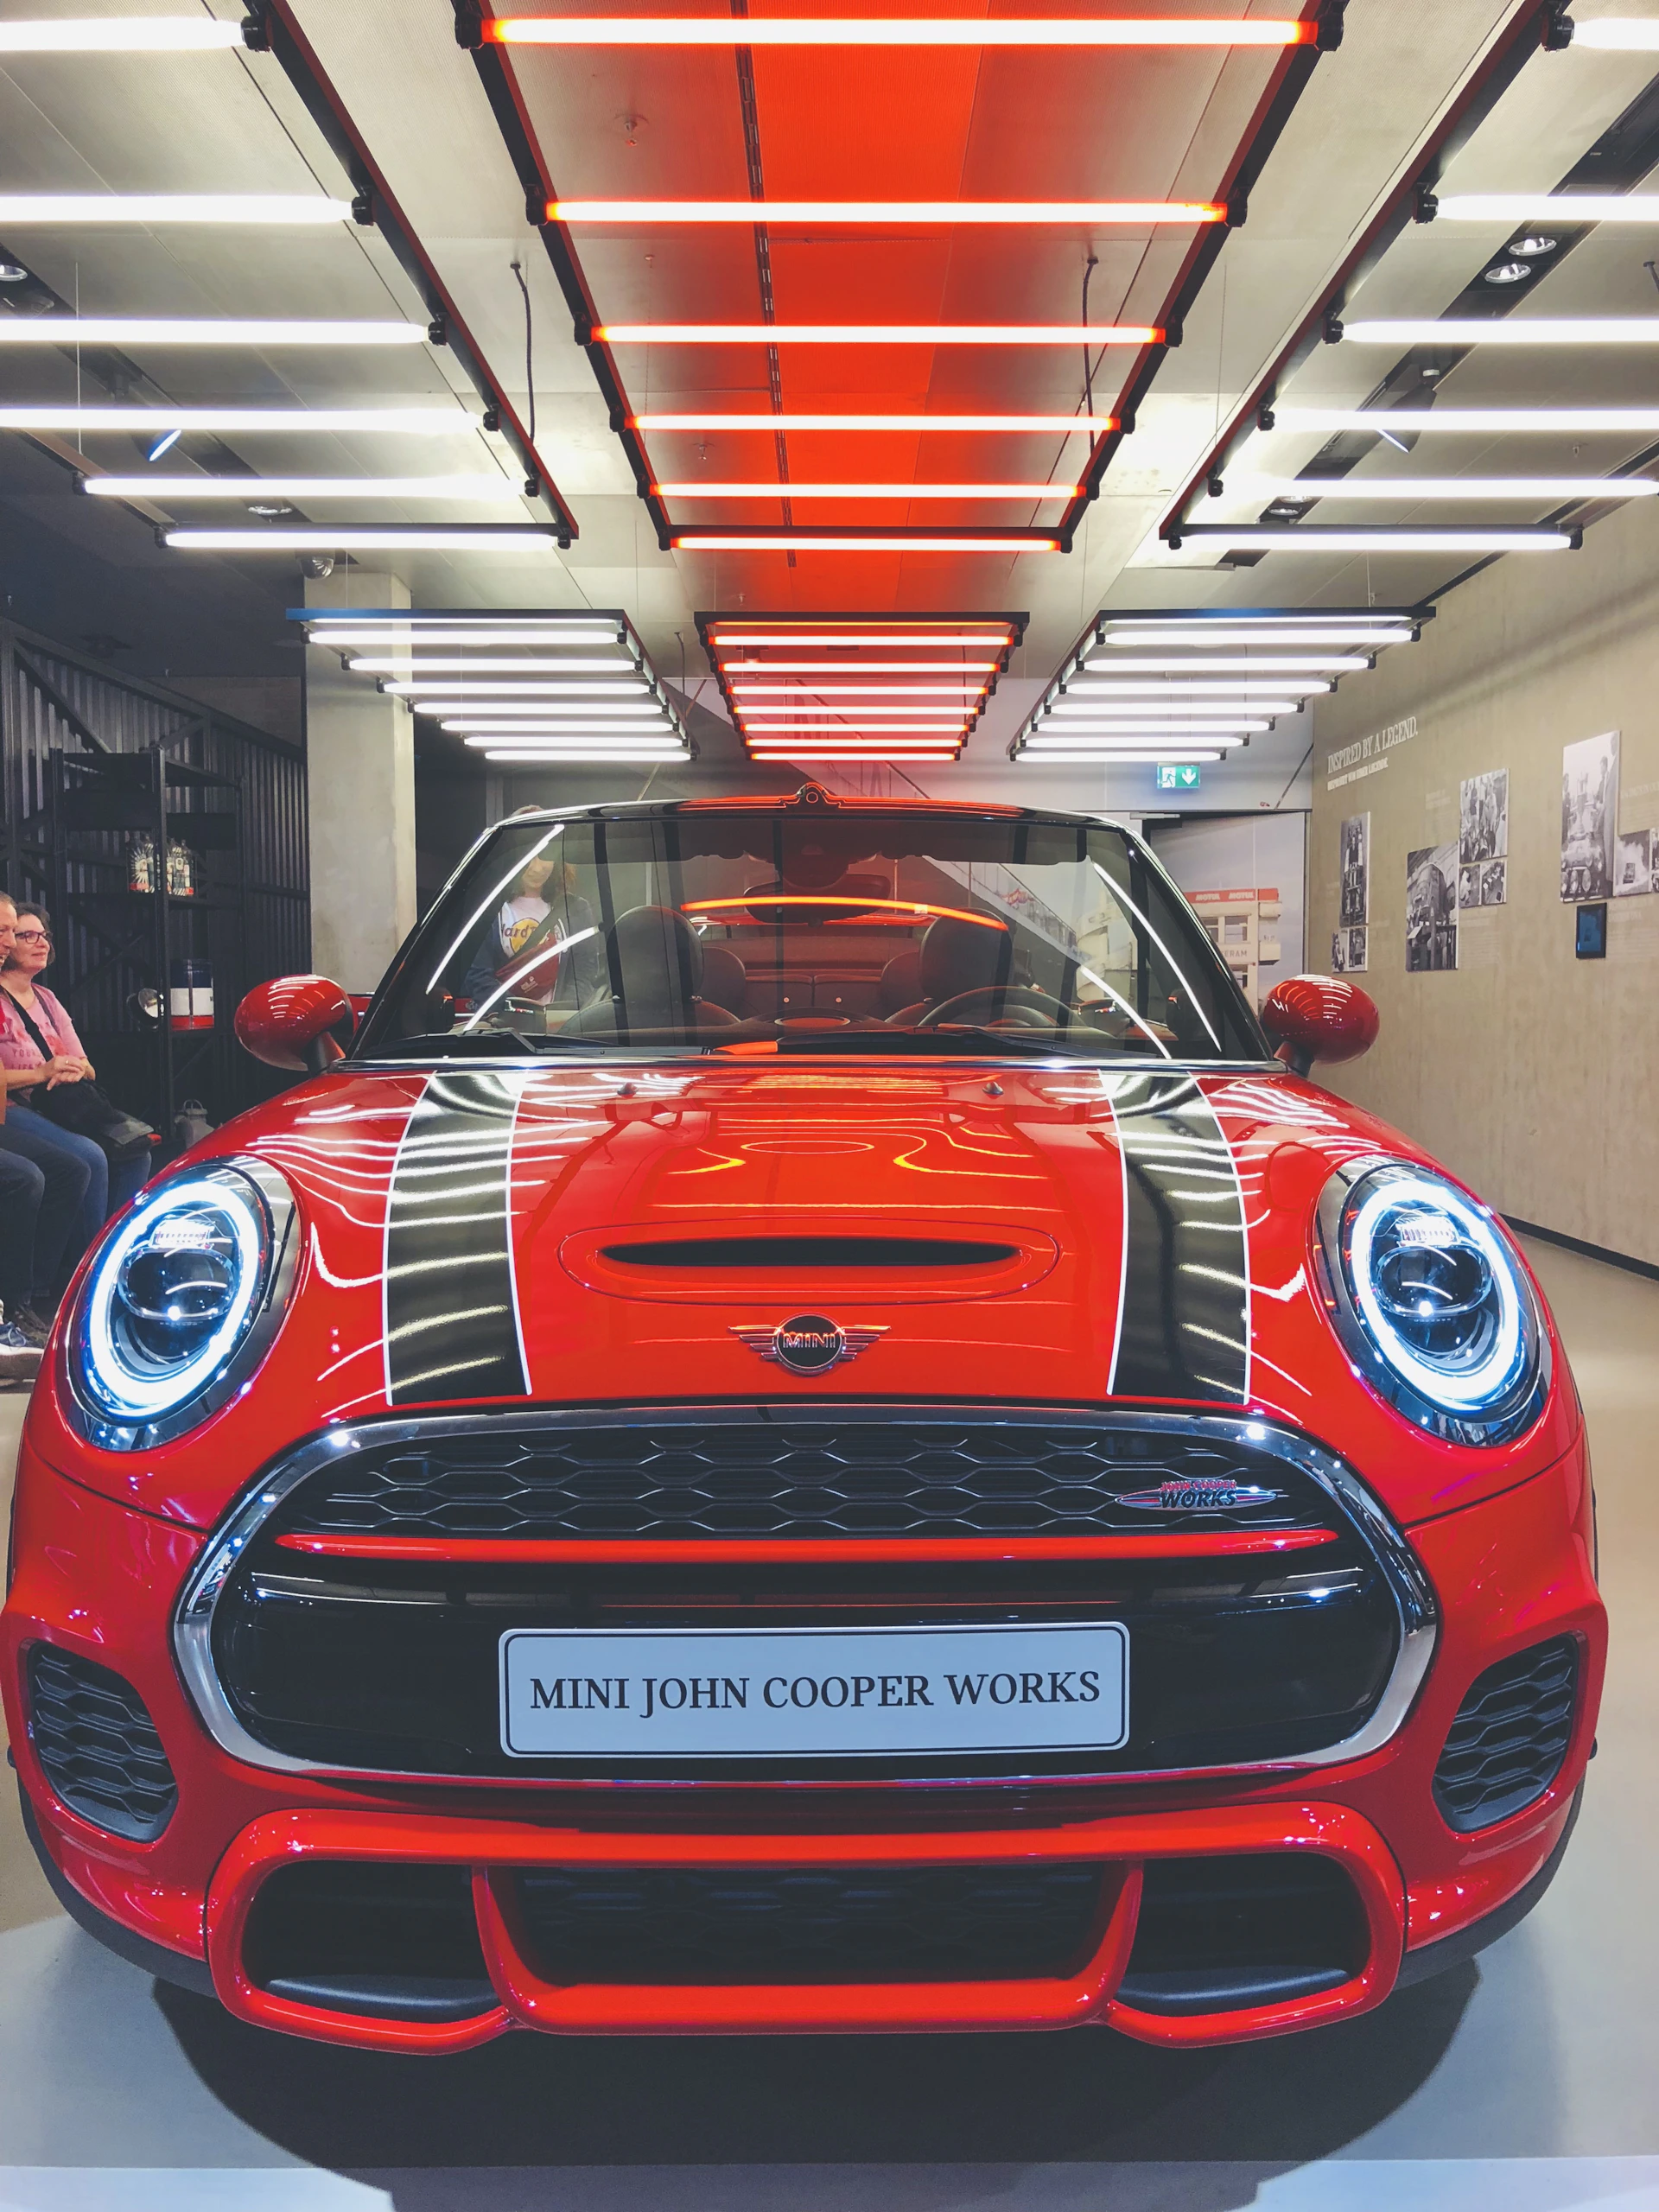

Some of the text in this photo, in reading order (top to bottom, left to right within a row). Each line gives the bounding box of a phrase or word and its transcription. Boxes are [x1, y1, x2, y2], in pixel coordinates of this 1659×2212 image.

[1327, 715, 1418, 774] INSPIRED BY A LEGEND.
[783, 1333, 836, 1348] MINI
[1160, 1479, 1236, 1491] JOHN COOPER
[1160, 1490, 1236, 1509] WORKS
[531, 1671, 1099, 1718] MINI JOHN COOPER WORKS
